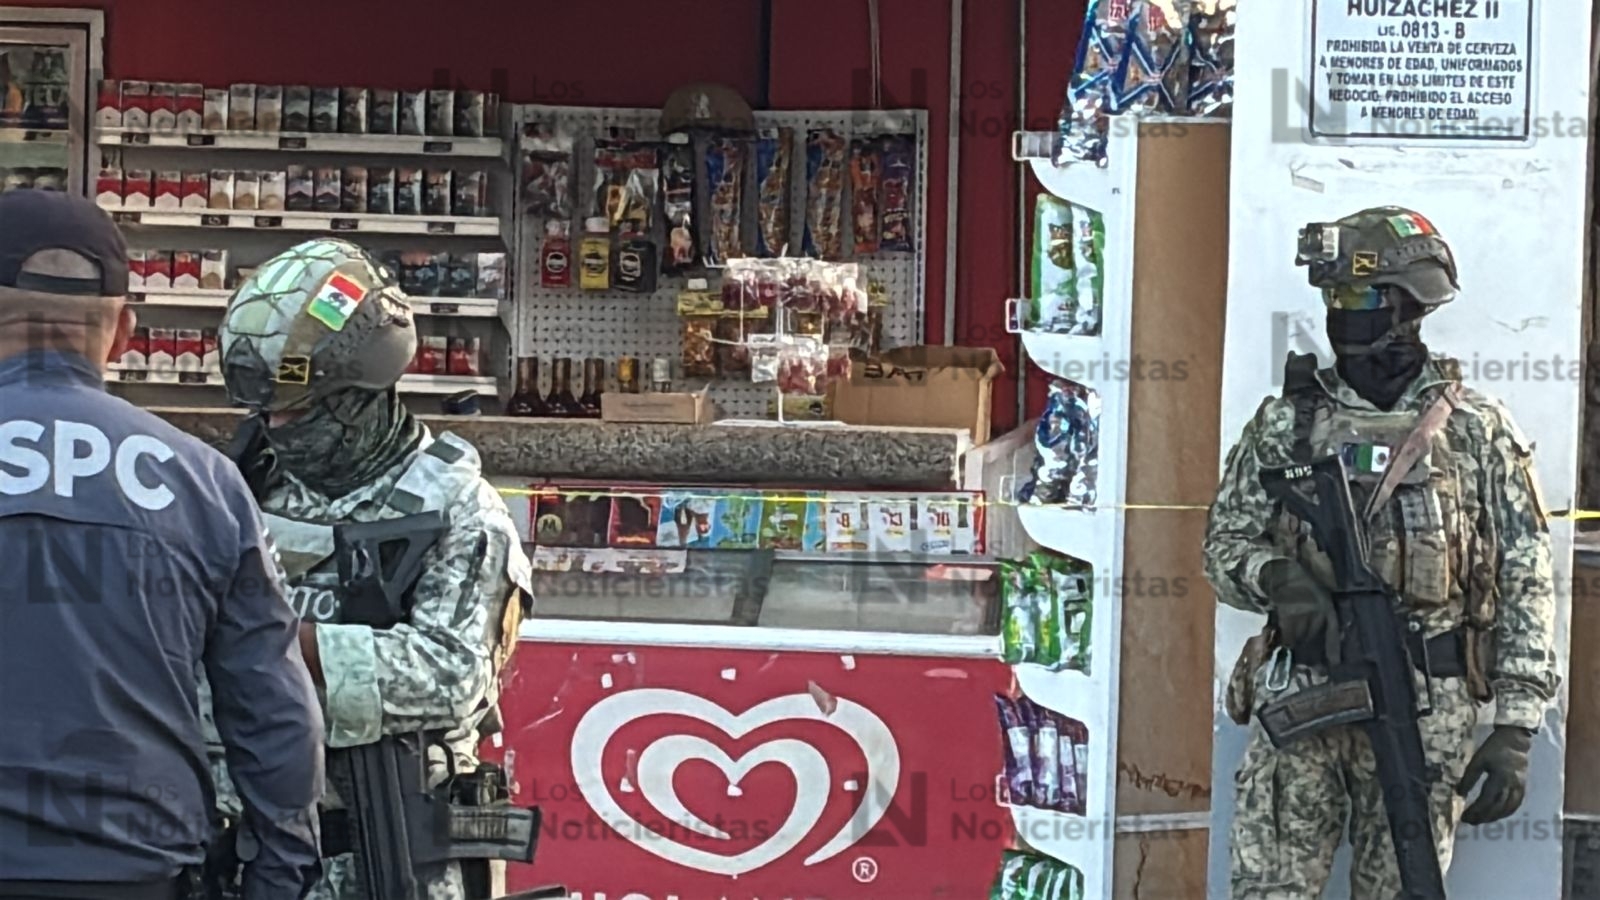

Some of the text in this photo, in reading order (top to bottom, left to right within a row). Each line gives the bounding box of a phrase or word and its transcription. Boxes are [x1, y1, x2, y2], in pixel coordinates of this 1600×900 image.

[1347, 0, 1499, 19] HUIZACHEZ II
[1401, 20, 1439, 38] 0813
[1455, 22, 1465, 39] B
[1326, 39, 1517, 56] PROHIBIDA LA VENTA DE CERVEZA
[1320, 56, 1327, 68] A
[1330, 56, 1384, 70] MENORES
[1387, 57, 1402, 70] DE
[1441, 58, 1522, 73] UNIFORMADOS
[1326, 72, 1516, 89] Y TOMAR EN LOS LIMITES DE ESTE
[1385, 89, 1448, 103] PROHIBIDO
[1450, 90, 1465, 104] EL
[1467, 91, 1512, 105] ACCESO
[1361, 106, 1368, 119] A
[1371, 106, 1425, 120] MENORES
[1428, 107, 1444, 120] DE
[0, 419, 175, 511] SPC
